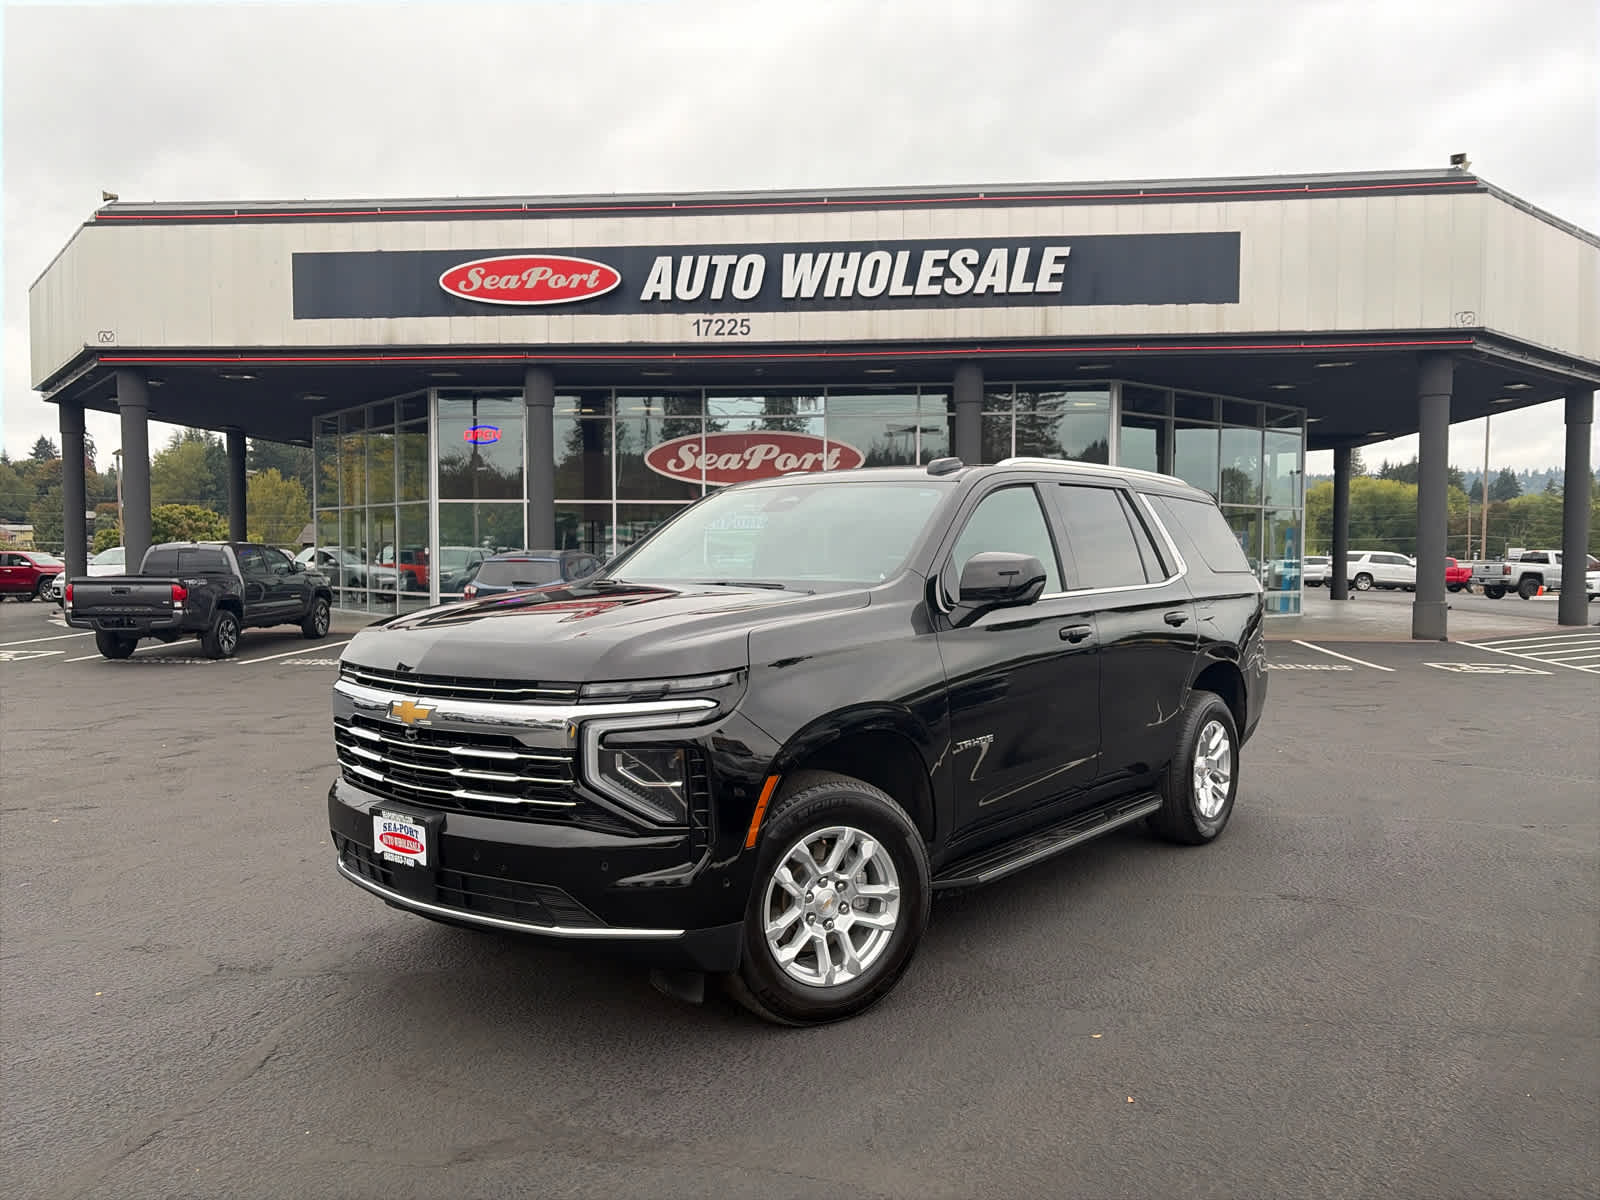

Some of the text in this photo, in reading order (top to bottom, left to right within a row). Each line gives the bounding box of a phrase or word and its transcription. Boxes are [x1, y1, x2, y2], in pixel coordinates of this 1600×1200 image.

[458, 266, 600, 292] SeaPort
[640, 246, 1071, 301] AUTO WHOLESALE
[692, 318, 751, 336] 17225
[464, 429, 502, 441] OPEN
[666, 443, 842, 472] SeaPort
